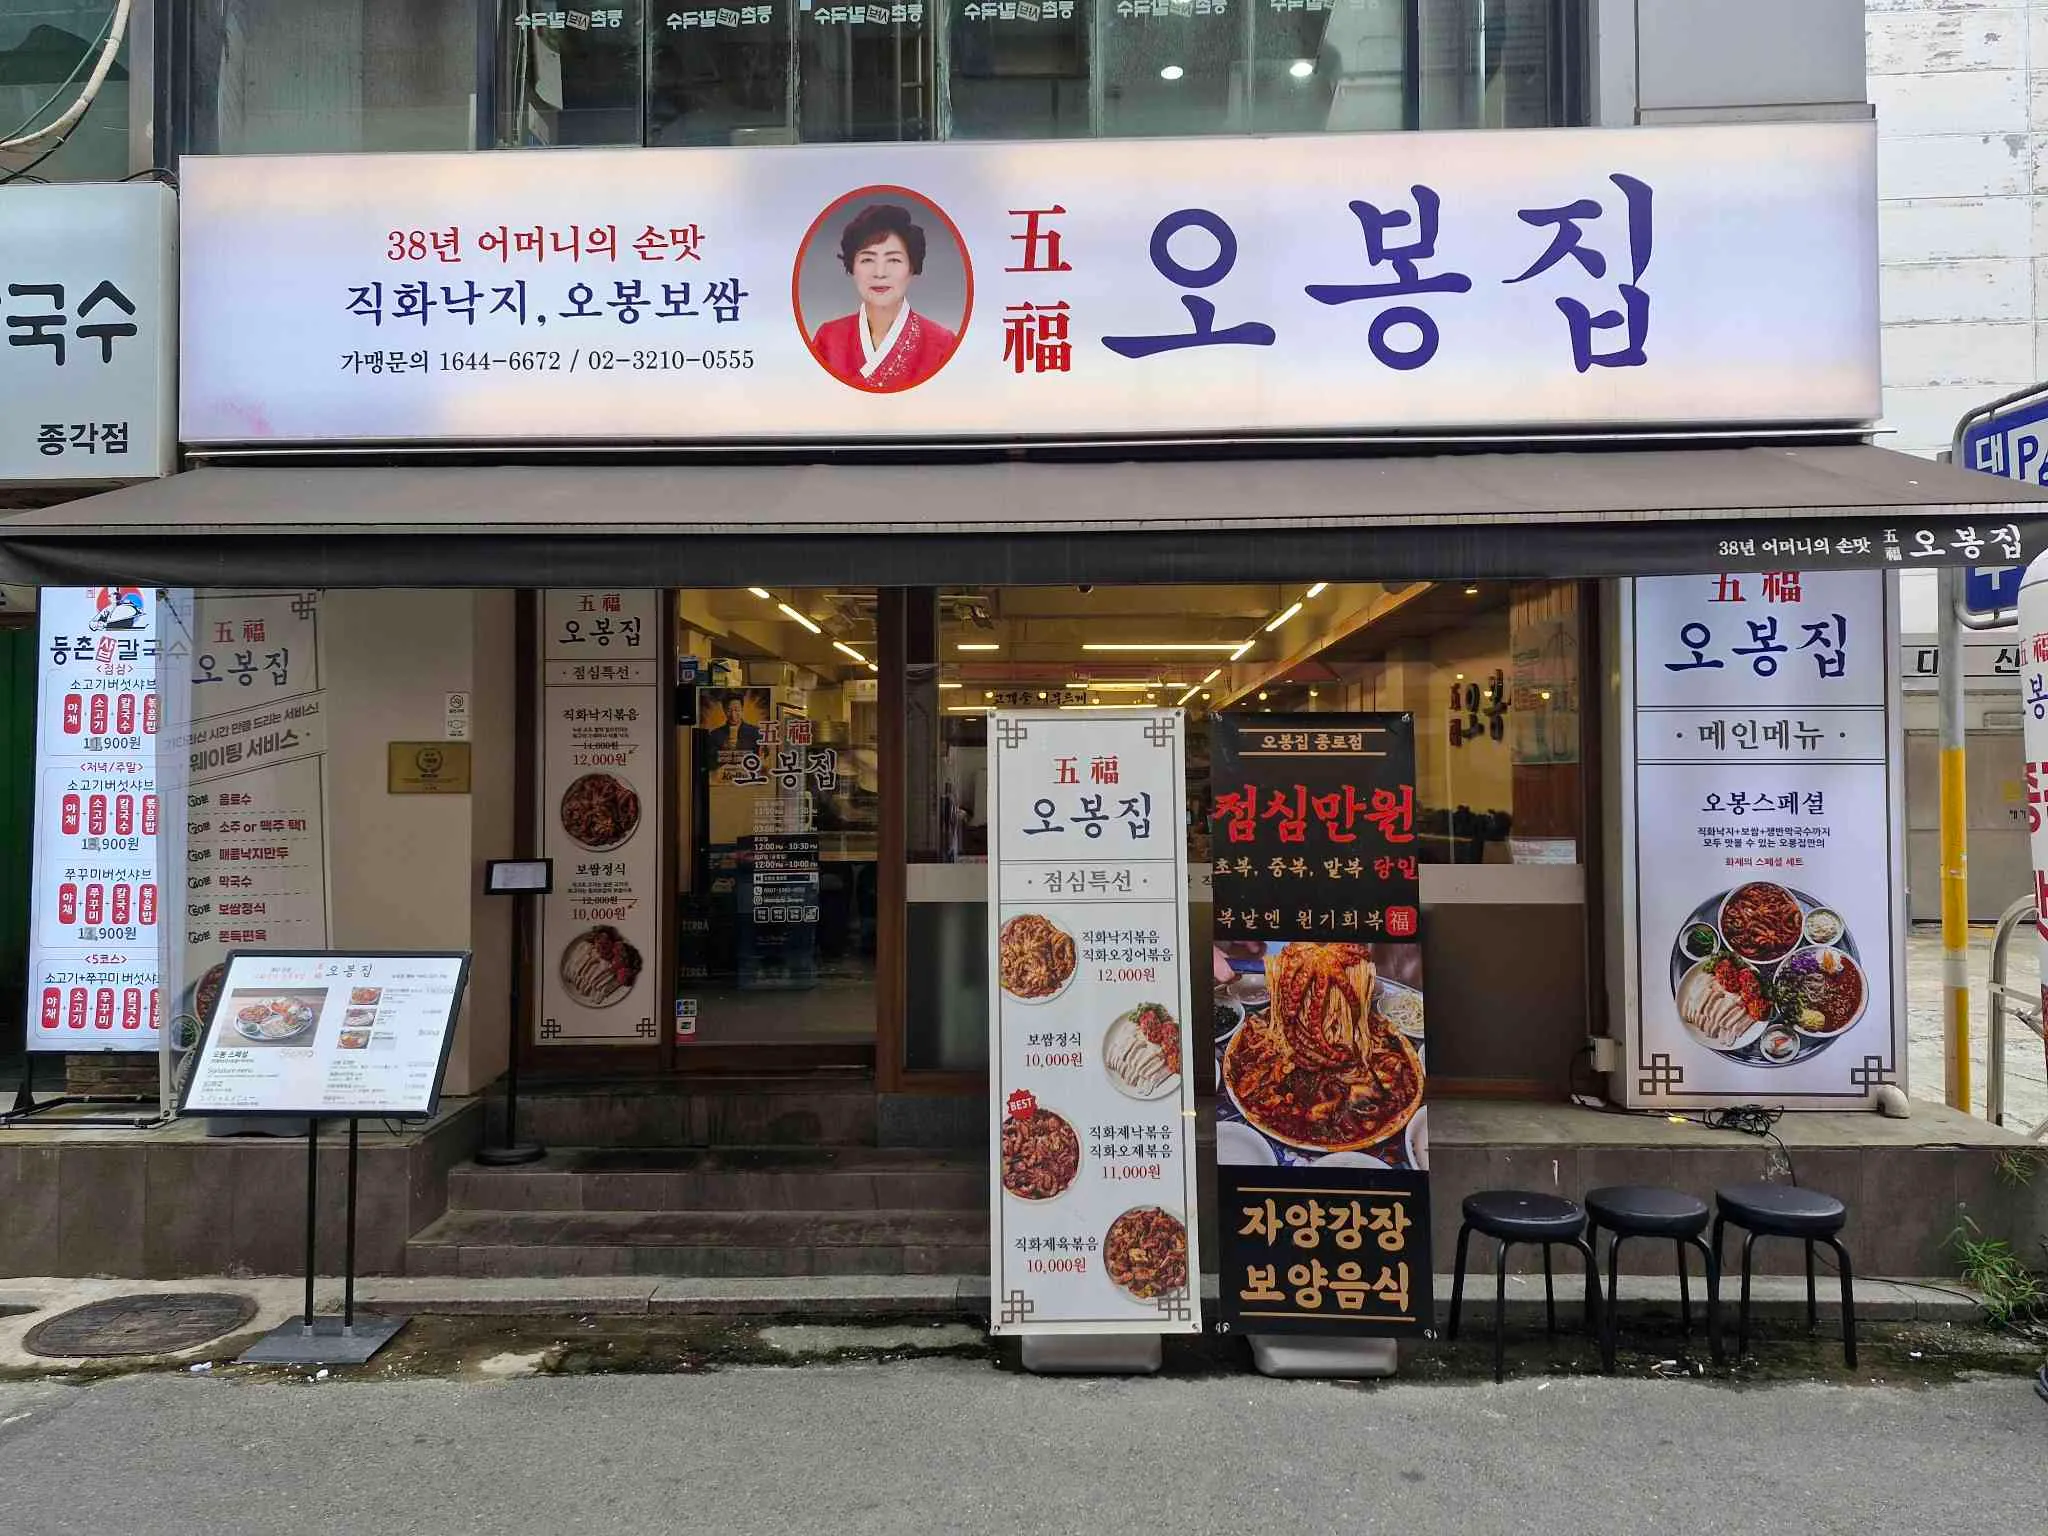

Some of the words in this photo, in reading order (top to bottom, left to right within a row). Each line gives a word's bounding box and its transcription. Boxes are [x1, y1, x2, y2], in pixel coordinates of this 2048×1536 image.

[387, 226, 461, 263] 38년
[477, 225, 616, 263] 어머니의
[631, 224, 706, 262] 손맛
[1101, 172, 1654, 373] 오봉집
[345, 279, 547, 327] 직화낙지,
[558, 277, 749, 325] 오봉보쌈
[0, 280, 138, 367] 국수
[340, 350, 429, 374] 가맹문의
[439, 350, 561, 372] 1644-6672
[588, 349, 755, 371] 02-3210-0555
[37, 421, 129, 456] 종각점
[1719, 538, 1756, 557] 38년
[1761, 536, 1830, 557] 어머니의
[1835, 536, 1871, 555] 손맛
[1909, 523, 2023, 560] 오봉집
[558, 616, 641, 647] 오봉집
[1664, 613, 1848, 679] 오봉집
[191, 647, 289, 687] 오봉집
[573, 665, 631, 680] 점심특선
[70, 679, 157, 691] 소고기버섯샤브
[563, 708, 641, 721] 직화낙지볶음
[1261, 734, 1309, 750] 오봉집
[1314, 733, 1363, 750] 종로점
[1698, 719, 1825, 752] 메인메뉴
[190, 742, 243, 772] 웨이팅
[246, 728, 299, 759] 서비스
[574, 753, 627, 767] 12,000원
[733, 748, 838, 792] 오봉집
[1053, 755, 1119, 785] 五福
[67, 780, 155, 792] 소고기버섯샤브
[1213, 783, 1416, 844] 점심만원
[1702, 791, 1825, 816] 오봉스페셜
[1022, 791, 1152, 840] 오봉집
[219, 821, 241, 834] 소주
[243, 824, 257, 833] or
[1703, 838, 1722, 849] 모두
[1746, 838, 1757, 849] 수
[1758, 838, 1777, 849] 있는
[1779, 838, 1826, 849] 오봉집만의
[575, 862, 626, 876] 보쌈정식
[1267, 857, 1314, 878] 중복,
[1323, 857, 1364, 879] 말복
[1373, 856, 1419, 881] 당일
[218, 875, 252, 888] 막국수
[1042, 869, 1133, 893] 점심특선
[218, 902, 267, 916] 보쌈정식
[572, 907, 627, 921] 10,000원
[1216, 908, 1281, 930] 복날엔
[1295, 908, 1384, 931] 원기회복
[1082, 930, 1160, 945] 직화낙지볶음
[1082, 948, 1174, 963] 직화오징어볶음
[1097, 967, 1156, 983] 12,000원
[1026, 1032, 1082, 1048] 보쌈정식
[1025, 1053, 1084, 1068] 10,000원
[1009, 1098, 1033, 1111] BEST
[1102, 1164, 1161, 1181] 11,000원
[1238, 1198, 1413, 1252] 자양강장
[1014, 1236, 1099, 1252] 직화제육볶음
[1026, 1257, 1087, 1275] 10,000원
[1239, 1258, 1410, 1313] 보양음식
